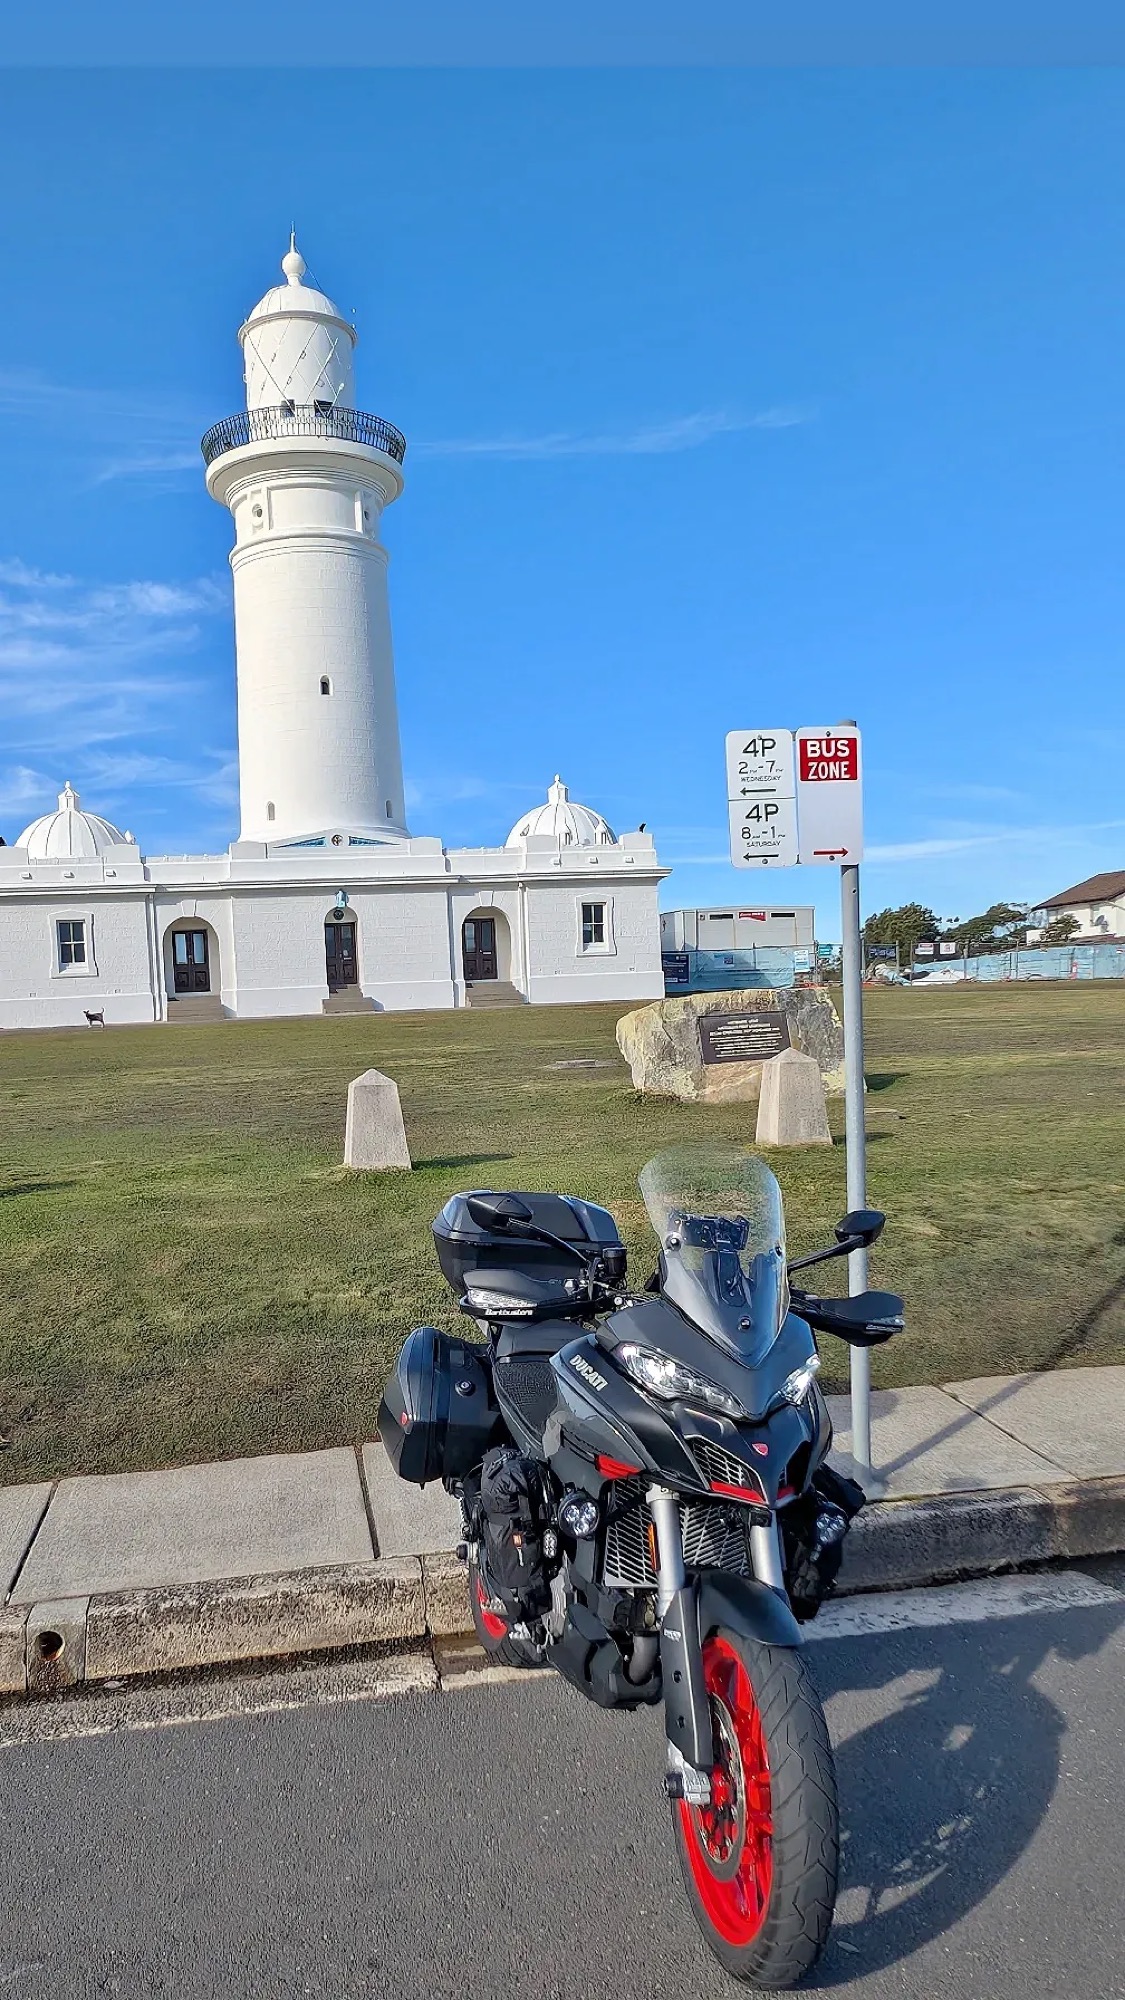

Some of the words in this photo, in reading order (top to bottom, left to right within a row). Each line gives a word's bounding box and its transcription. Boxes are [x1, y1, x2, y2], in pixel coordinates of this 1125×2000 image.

[742, 738, 776, 757] 4P
[807, 740, 850, 758] BUS
[808, 761, 851, 780] ZONE
[745, 803, 779, 822] 4P
[569, 1354, 608, 1391] DUCATI
